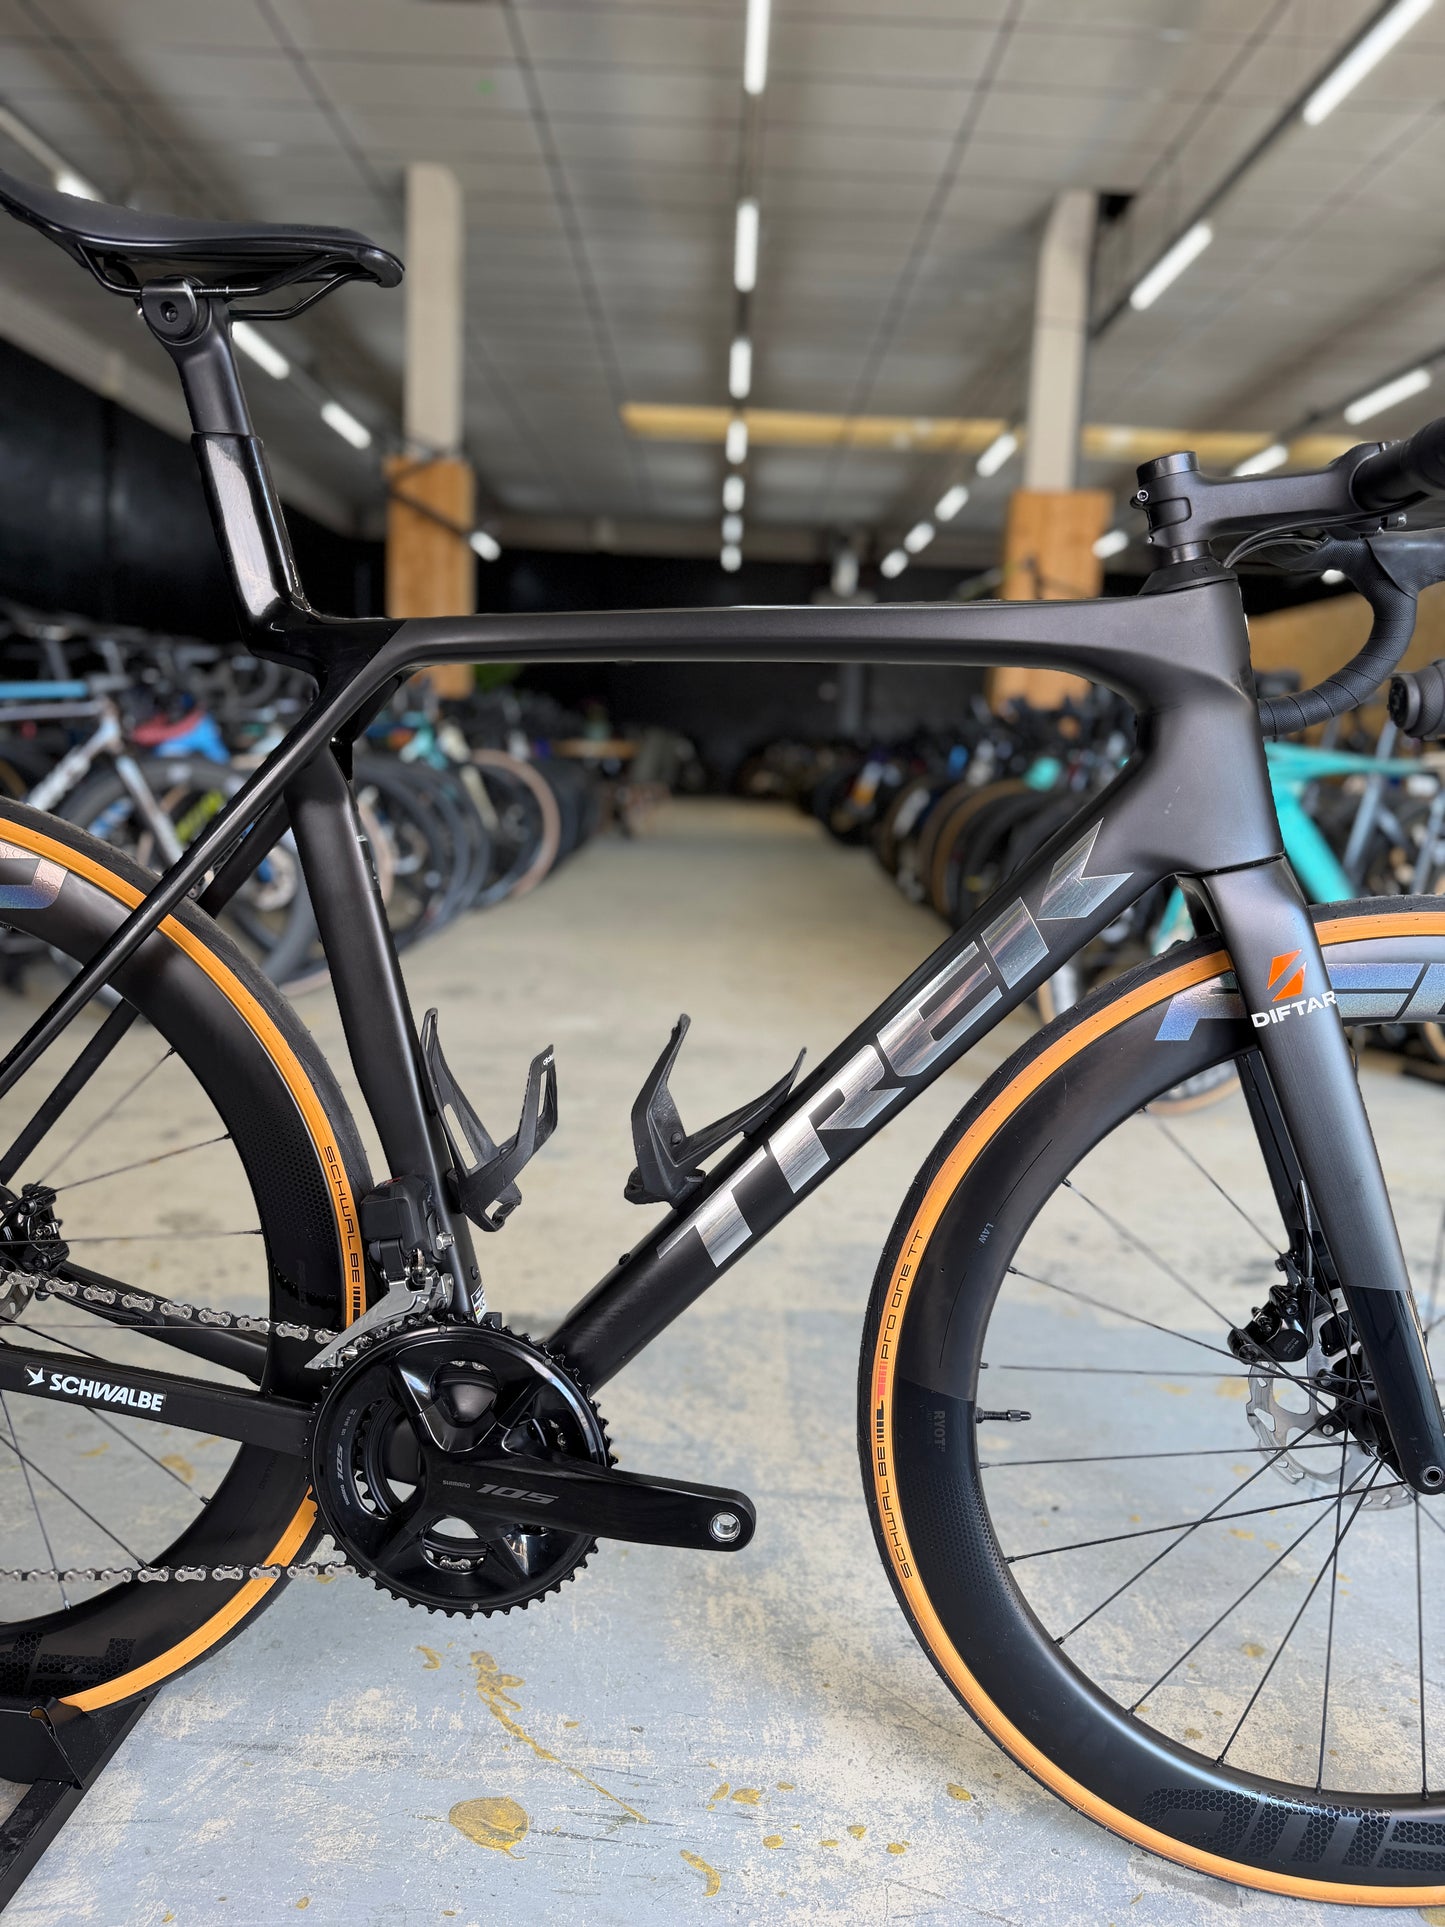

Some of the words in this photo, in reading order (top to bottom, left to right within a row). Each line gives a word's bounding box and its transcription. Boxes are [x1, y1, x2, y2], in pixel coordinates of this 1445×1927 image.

[1250, 990, 1337, 1029] DIFTAR
[657, 817, 1134, 1267] TREK
[323, 1145, 360, 1283] SCHWALBE
[978, 1222, 994, 1244] LAW
[48, 1373, 165, 1412] SCHWALBE
[876, 1446, 913, 1579] SCHWALBE
[907, 1229, 923, 1258] TT
[476, 1483, 560, 1505] 105
